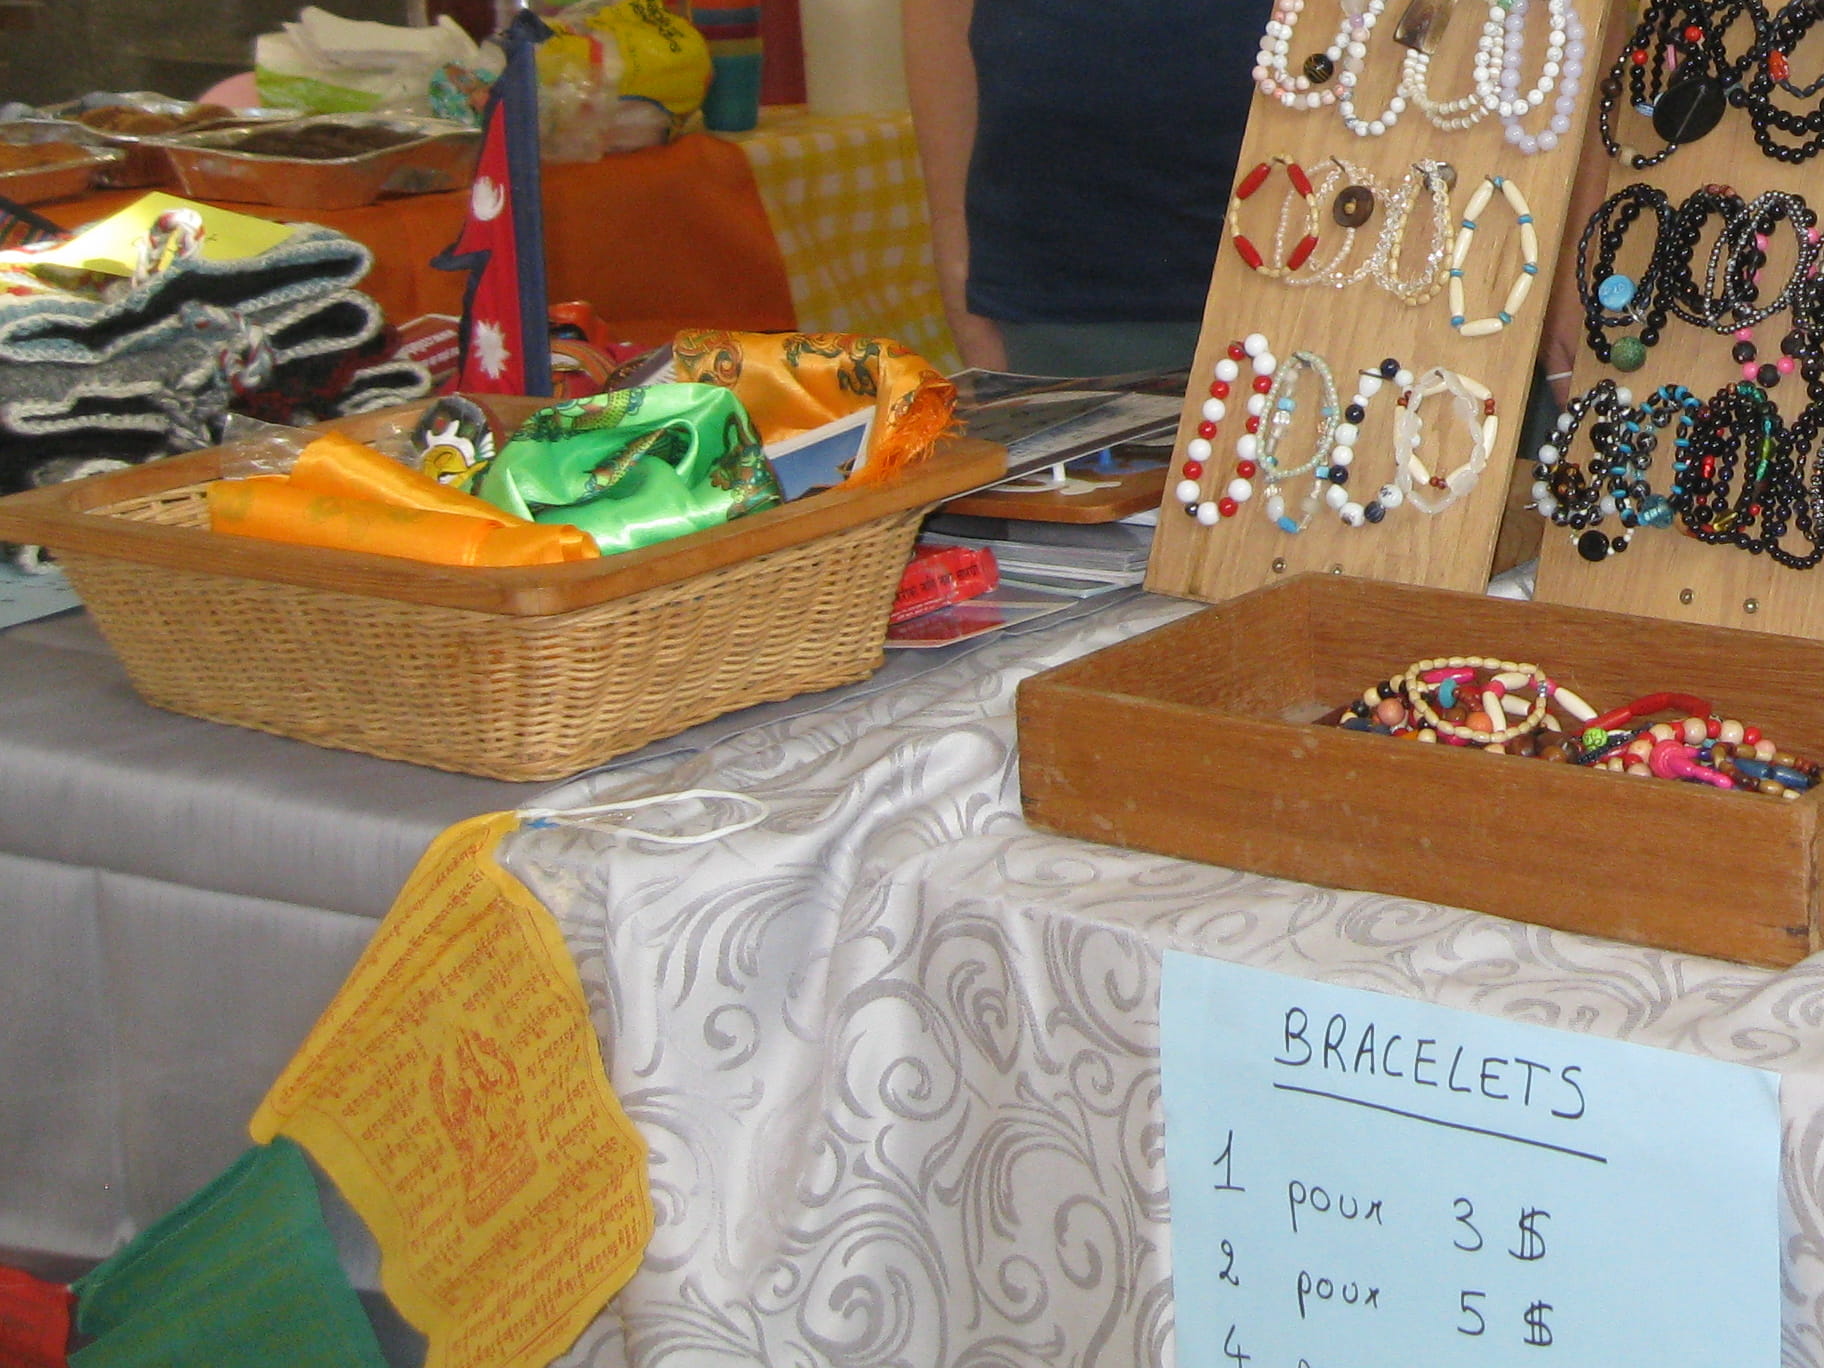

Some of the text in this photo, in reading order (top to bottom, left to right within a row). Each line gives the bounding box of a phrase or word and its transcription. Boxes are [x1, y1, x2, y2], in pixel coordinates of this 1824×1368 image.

[1275, 1007, 1586, 1120] BRACELETS
[1212, 1129, 1552, 1261] 1 pour 3 $
[1218, 1238, 1554, 1347] 2 pour 5 $
[1222, 1324, 1252, 1368] 4
